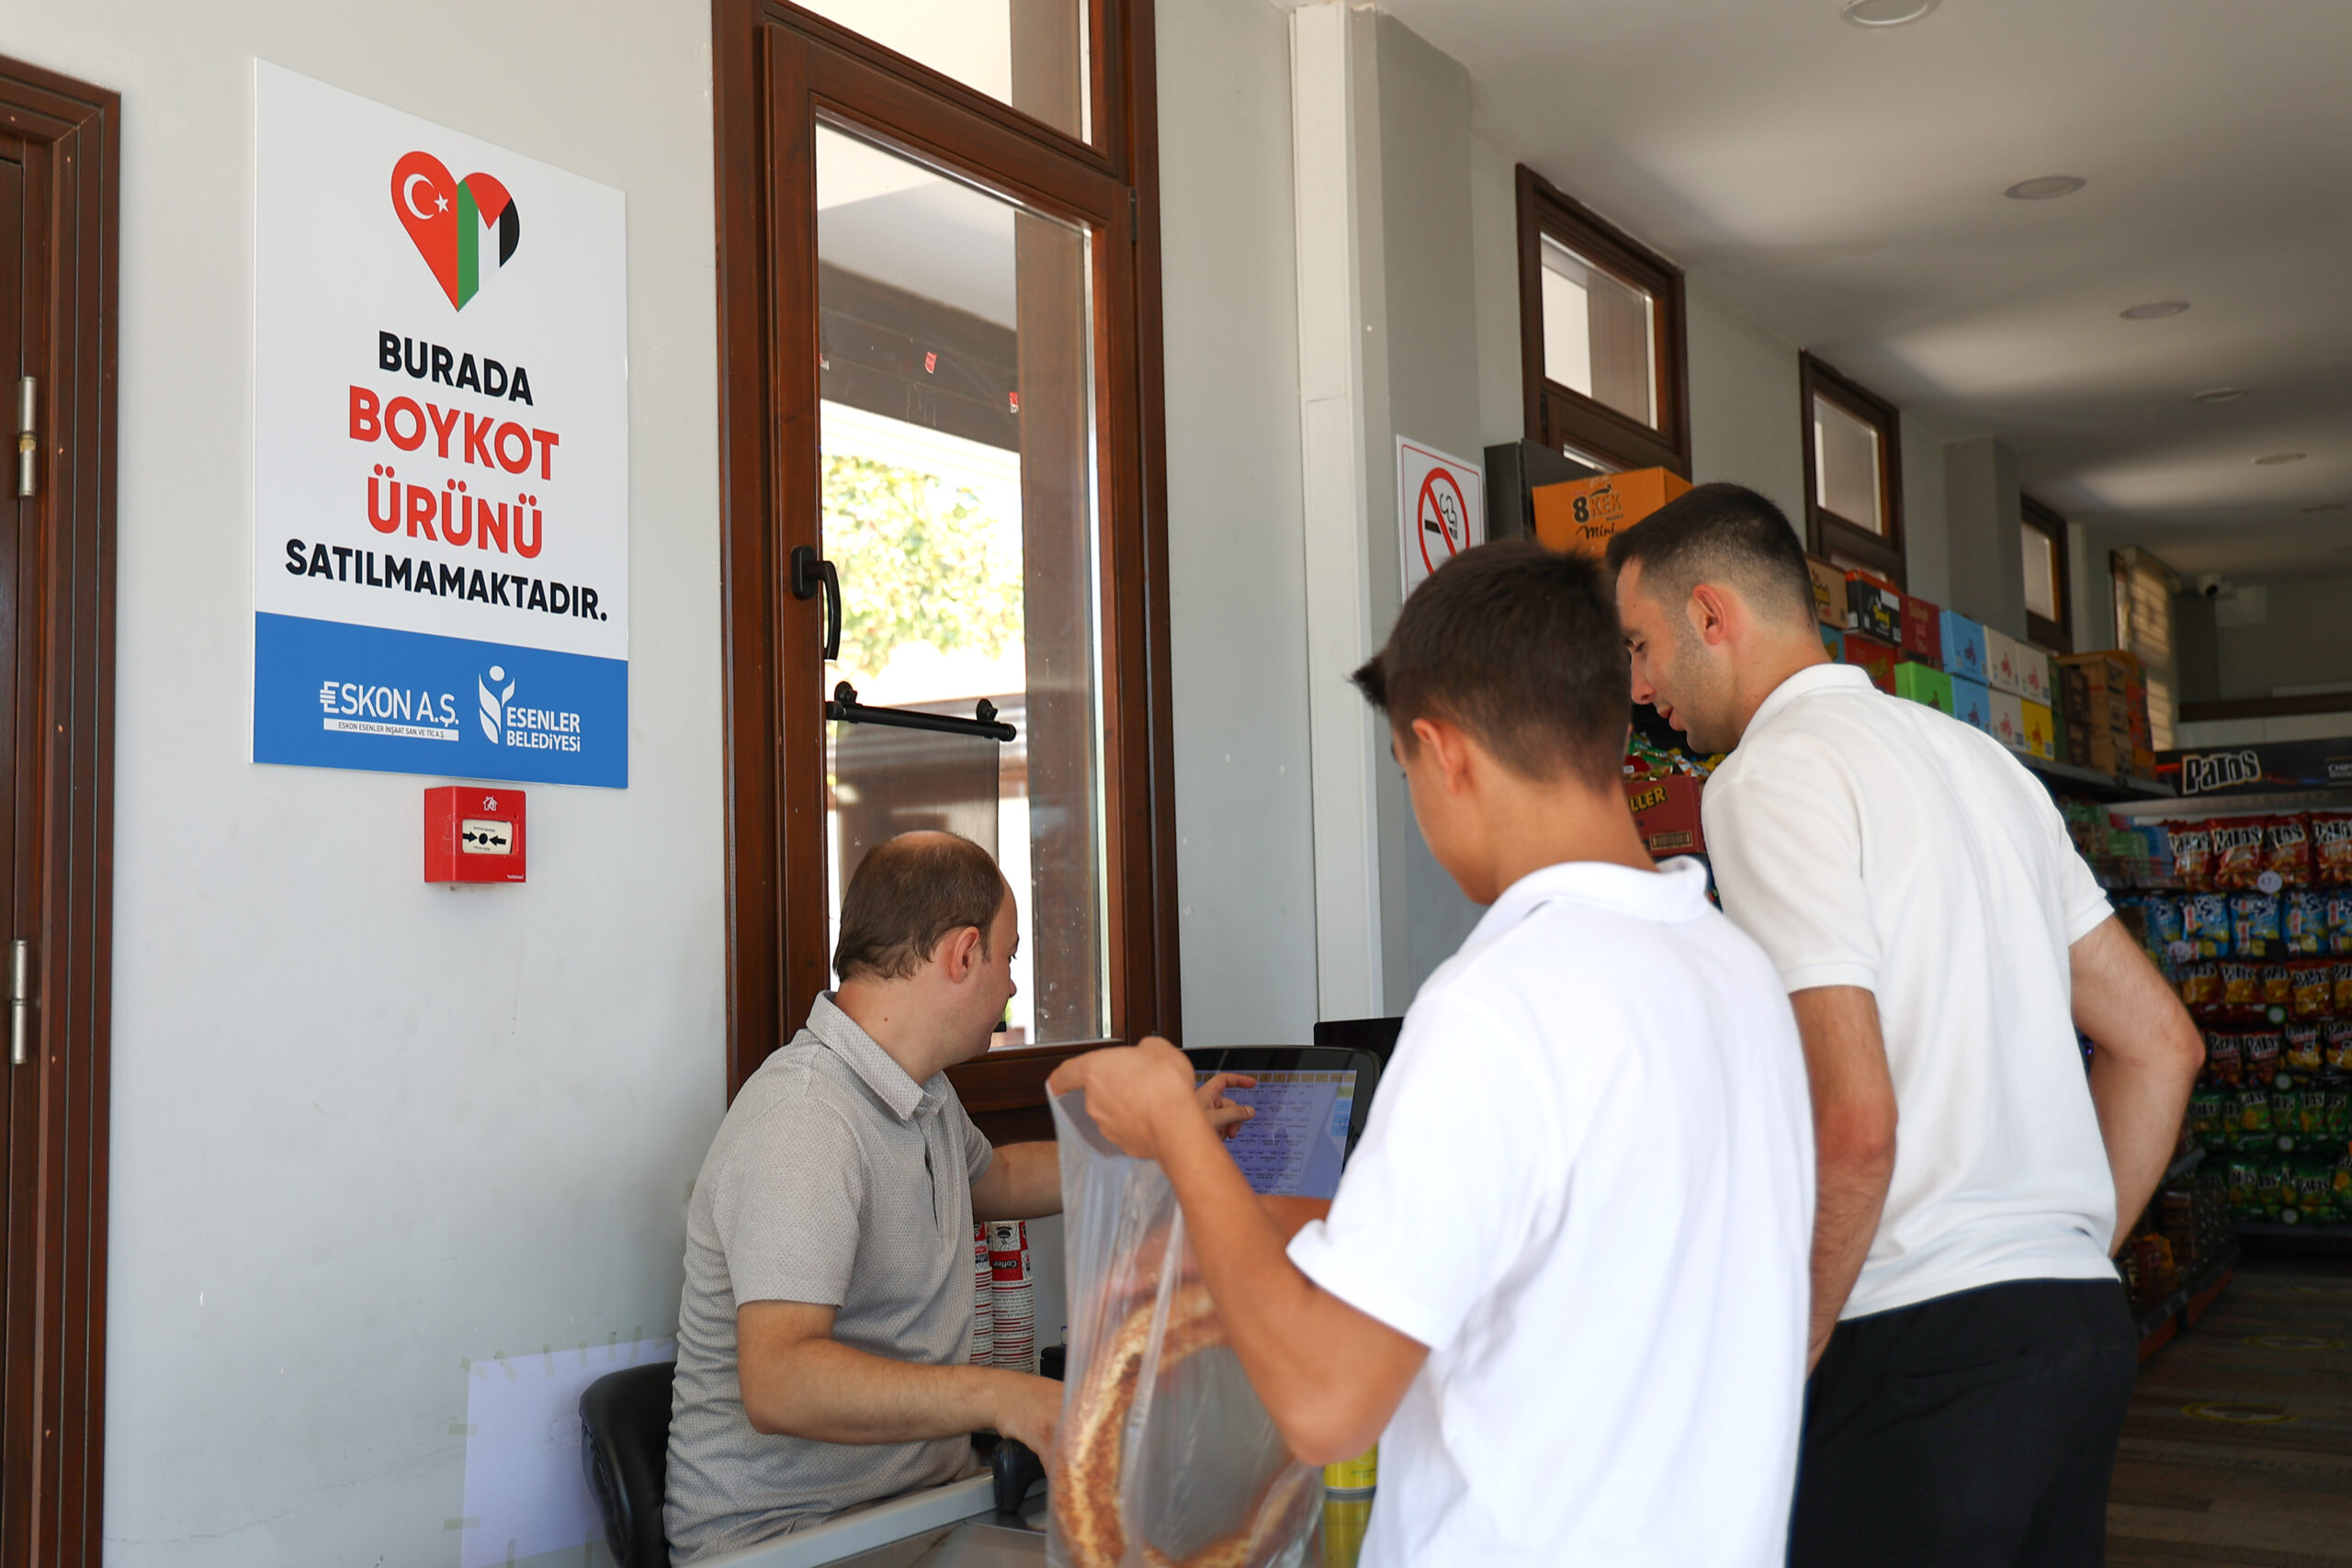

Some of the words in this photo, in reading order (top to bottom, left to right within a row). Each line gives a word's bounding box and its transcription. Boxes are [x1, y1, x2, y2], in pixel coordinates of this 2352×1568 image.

[379, 330, 534, 407] BURADA
[349, 384, 560, 481] BOYKOT
[368, 463, 543, 559] ÜRÜNÜ
[285, 537, 608, 622] SATILMAMAKTADIR.
[320, 681, 412, 721] ESKON
[415, 691, 459, 728] A.Ş.
[338, 721, 358, 730] ESKON
[358, 723, 384, 733] ESENLER
[506, 705, 582, 734] ESENLER
[1629, 785, 1668, 812] LLER
